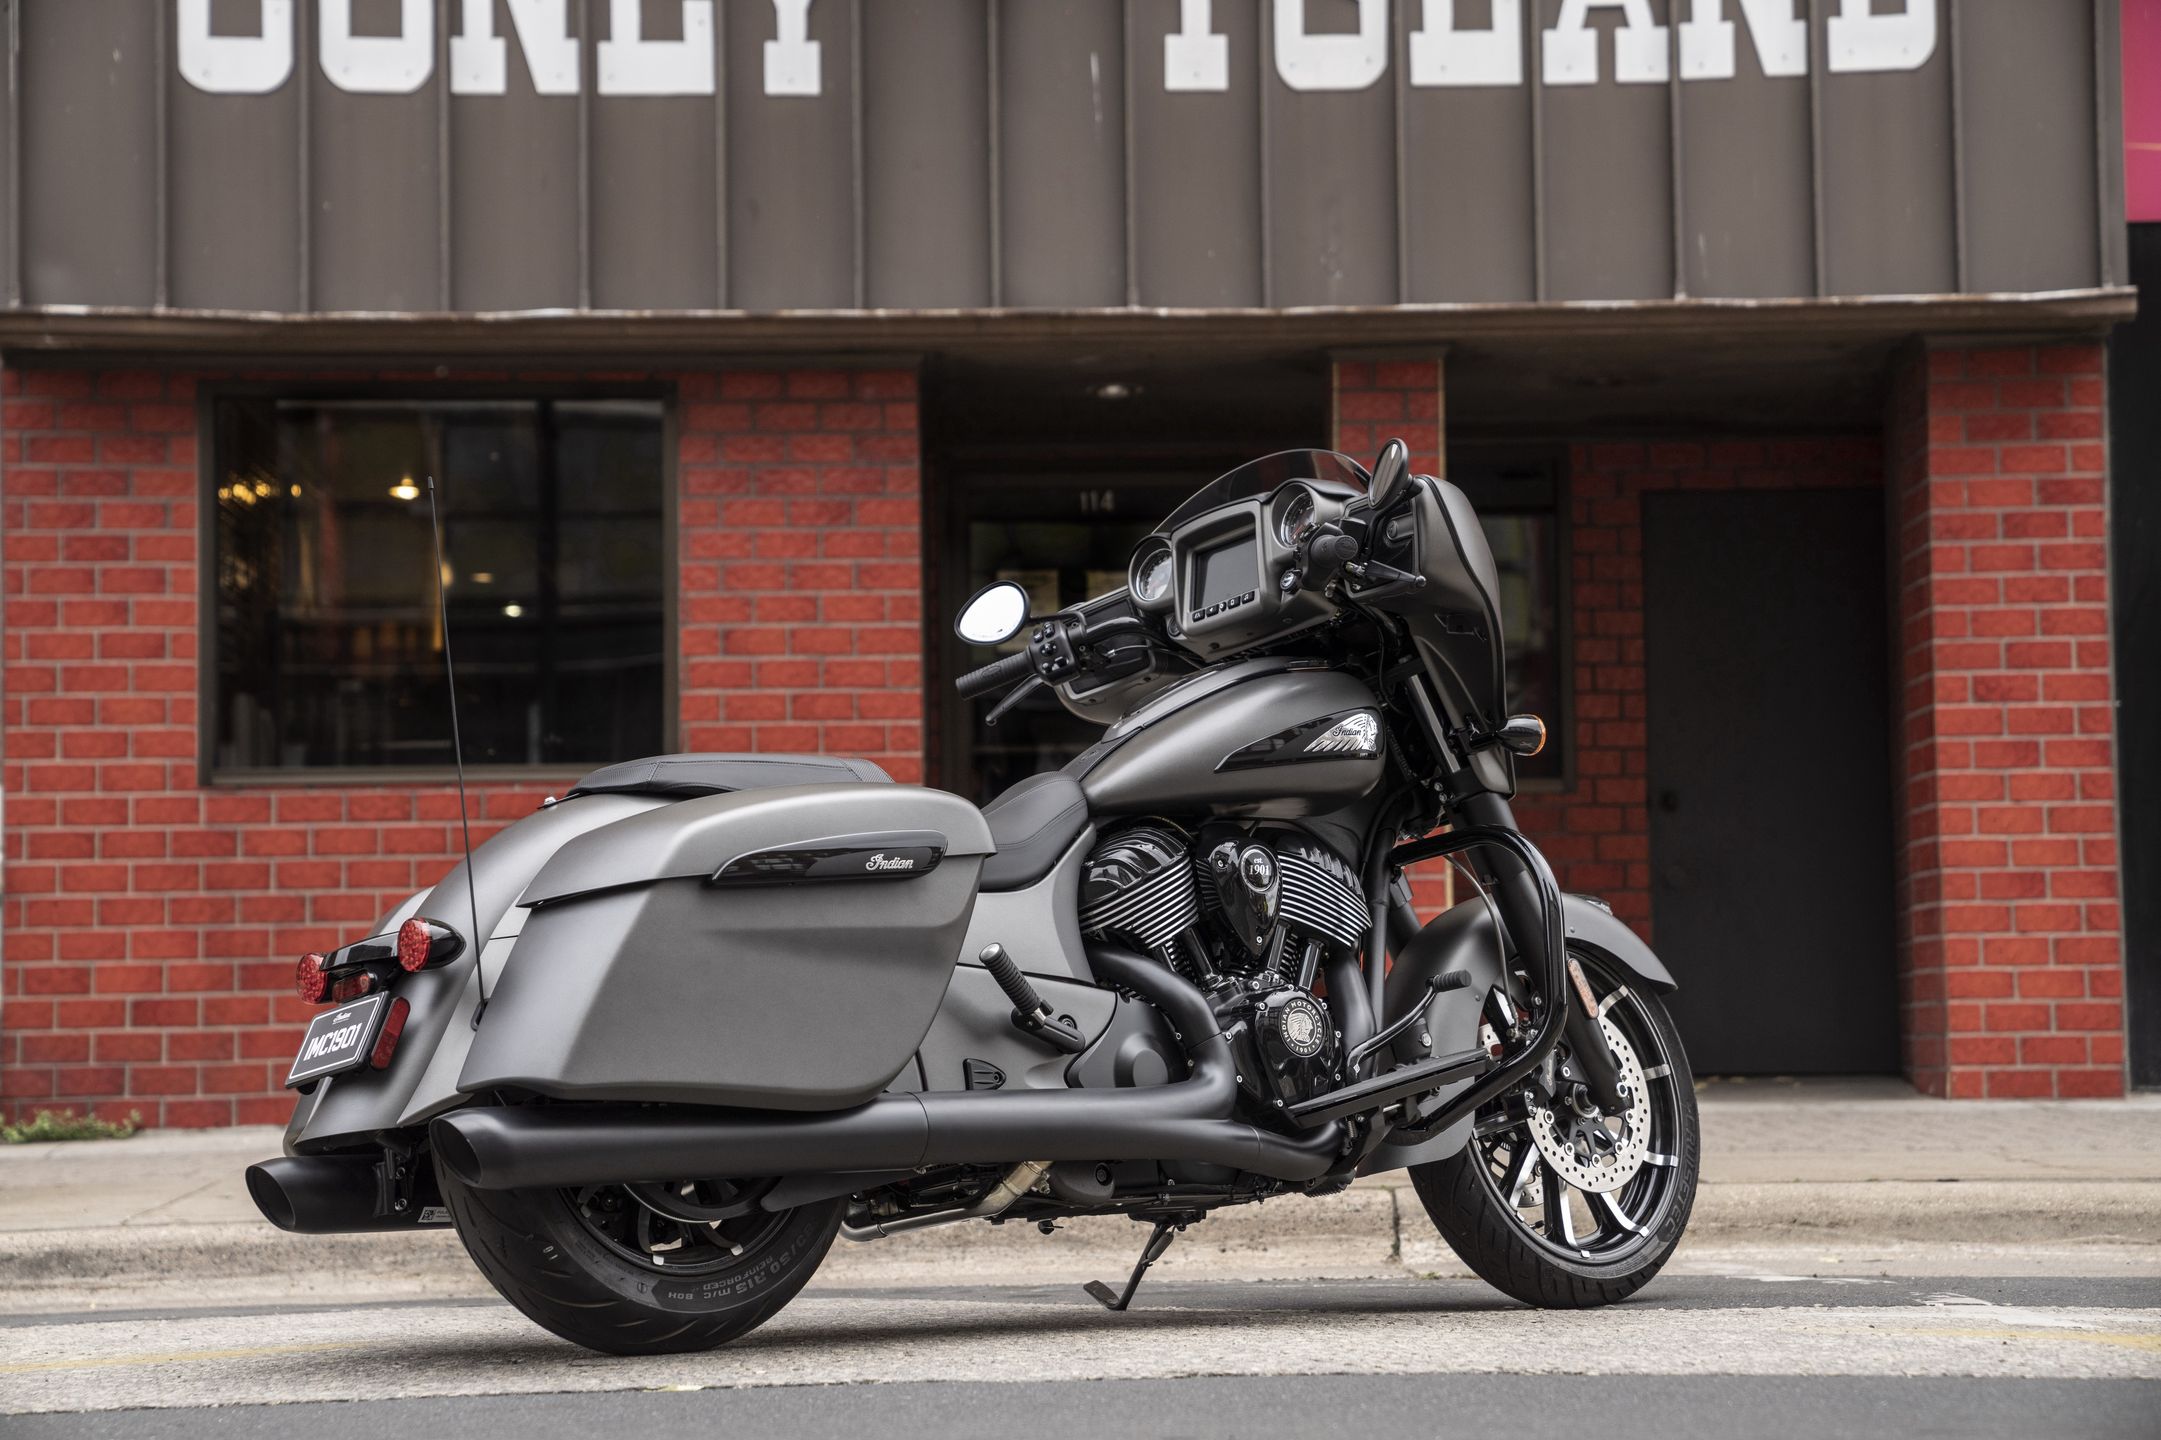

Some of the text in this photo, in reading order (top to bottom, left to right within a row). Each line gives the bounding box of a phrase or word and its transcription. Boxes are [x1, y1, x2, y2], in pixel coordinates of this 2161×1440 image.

[1080, 490, 1115, 512] 114
[1332, 726, 1362, 737] Indian
[865, 853, 914, 871] Indian
[1249, 864, 1270, 876] 1901
[1281, 1000, 1322, 1044] INDIAN MOTORCYCLE
[303, 1023, 363, 1061] IMC1901
[1664, 1113, 1697, 1235] CRUISETEC
